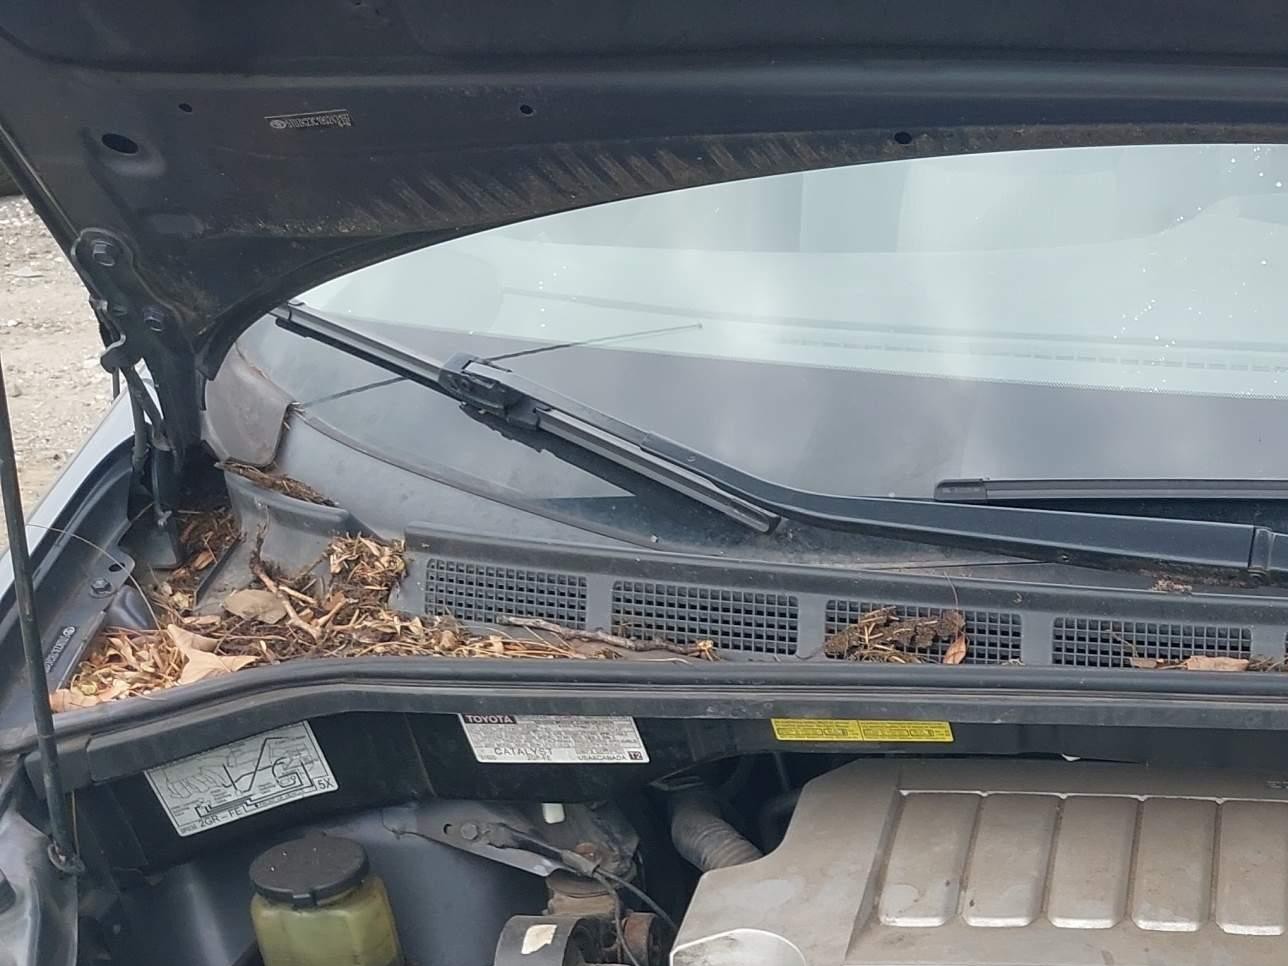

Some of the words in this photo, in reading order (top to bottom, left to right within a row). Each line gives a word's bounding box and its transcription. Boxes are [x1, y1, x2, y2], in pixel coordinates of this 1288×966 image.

[466, 714, 513, 724] TOYOTA
[494, 747, 553, 756] CATALYST
[318, 777, 335, 791] 5X
